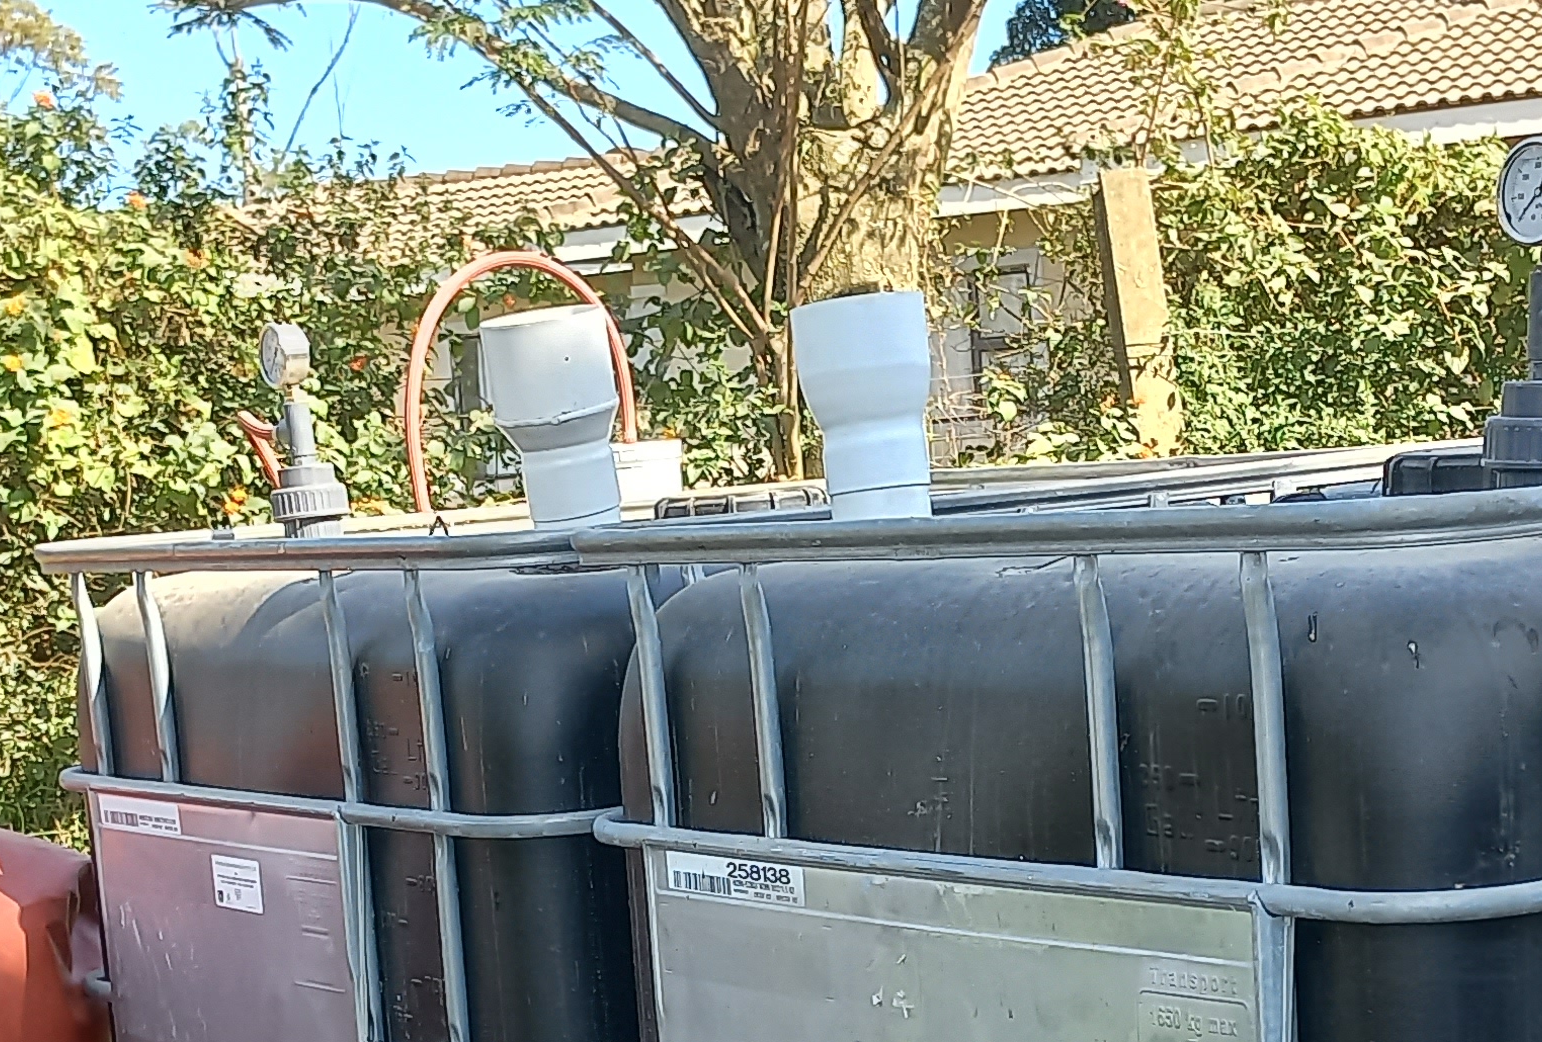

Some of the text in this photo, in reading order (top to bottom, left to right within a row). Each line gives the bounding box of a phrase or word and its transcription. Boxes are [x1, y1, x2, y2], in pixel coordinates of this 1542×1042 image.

[725, 861, 792, 885] 258138
[1148, 966, 1239, 997] Transport
[1207, 1017, 1239, 1037] max
